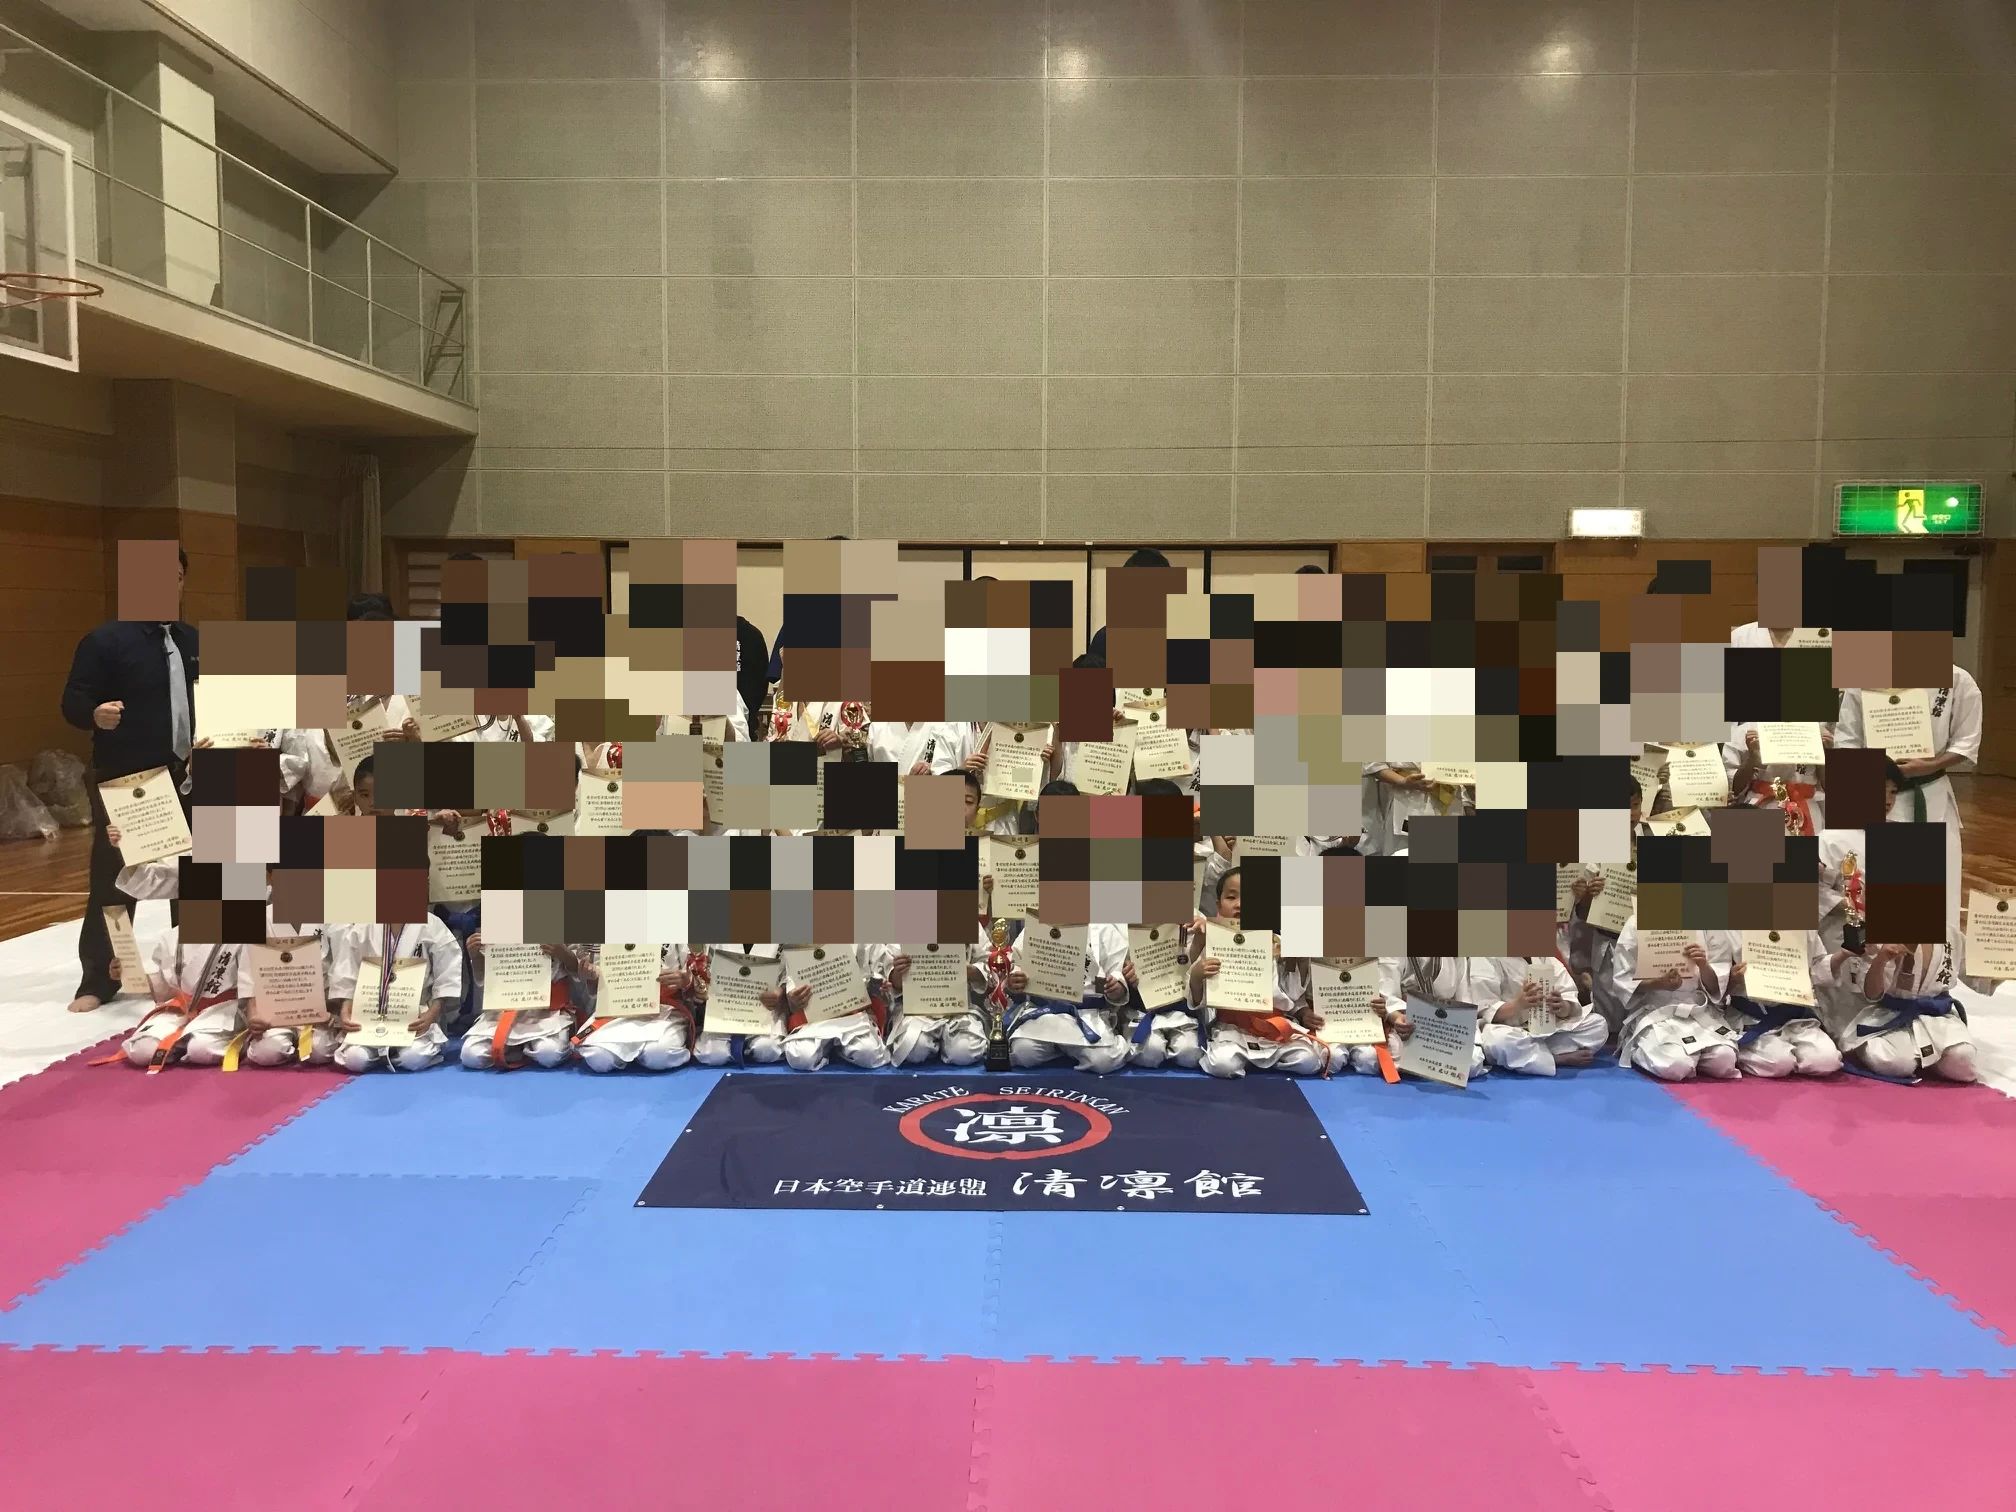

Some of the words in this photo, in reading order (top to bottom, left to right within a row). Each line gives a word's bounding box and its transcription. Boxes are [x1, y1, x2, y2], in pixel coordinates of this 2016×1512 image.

[882, 1086, 970, 1113] KARATE
[773, 1178, 988, 1196] 日本空手道連盟
